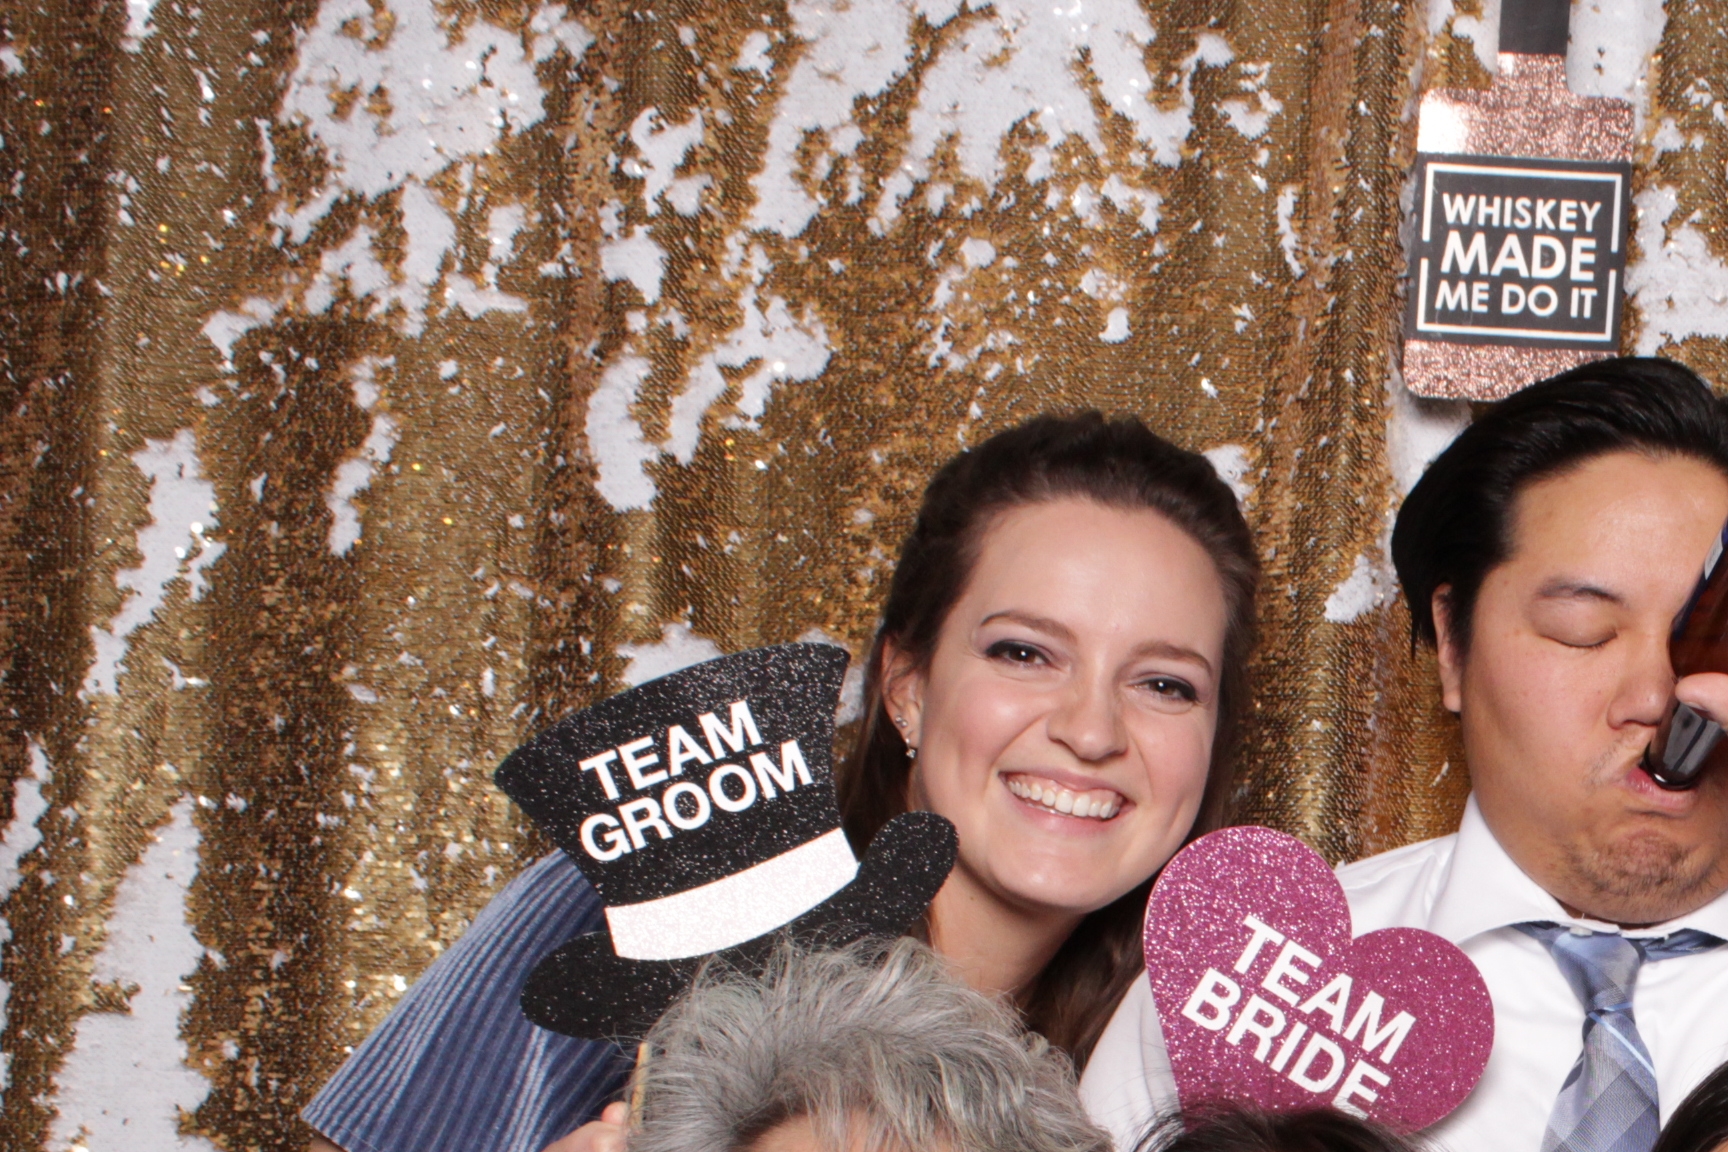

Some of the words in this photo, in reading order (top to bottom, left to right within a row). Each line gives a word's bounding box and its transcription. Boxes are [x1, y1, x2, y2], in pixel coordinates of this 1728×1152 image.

[1440, 230, 1597, 282] MADE
[1441, 193, 1602, 232] WHISKEY
[1435, 280, 1490, 313] ME
[1501, 284, 1558, 317] DO
[1570, 287, 1598, 319] IT
[579, 700, 763, 801] TEAM
[580, 740, 814, 862] GROOM
[1233, 914, 1417, 1065] TEAM
[1181, 967, 1391, 1121] BRIDE
